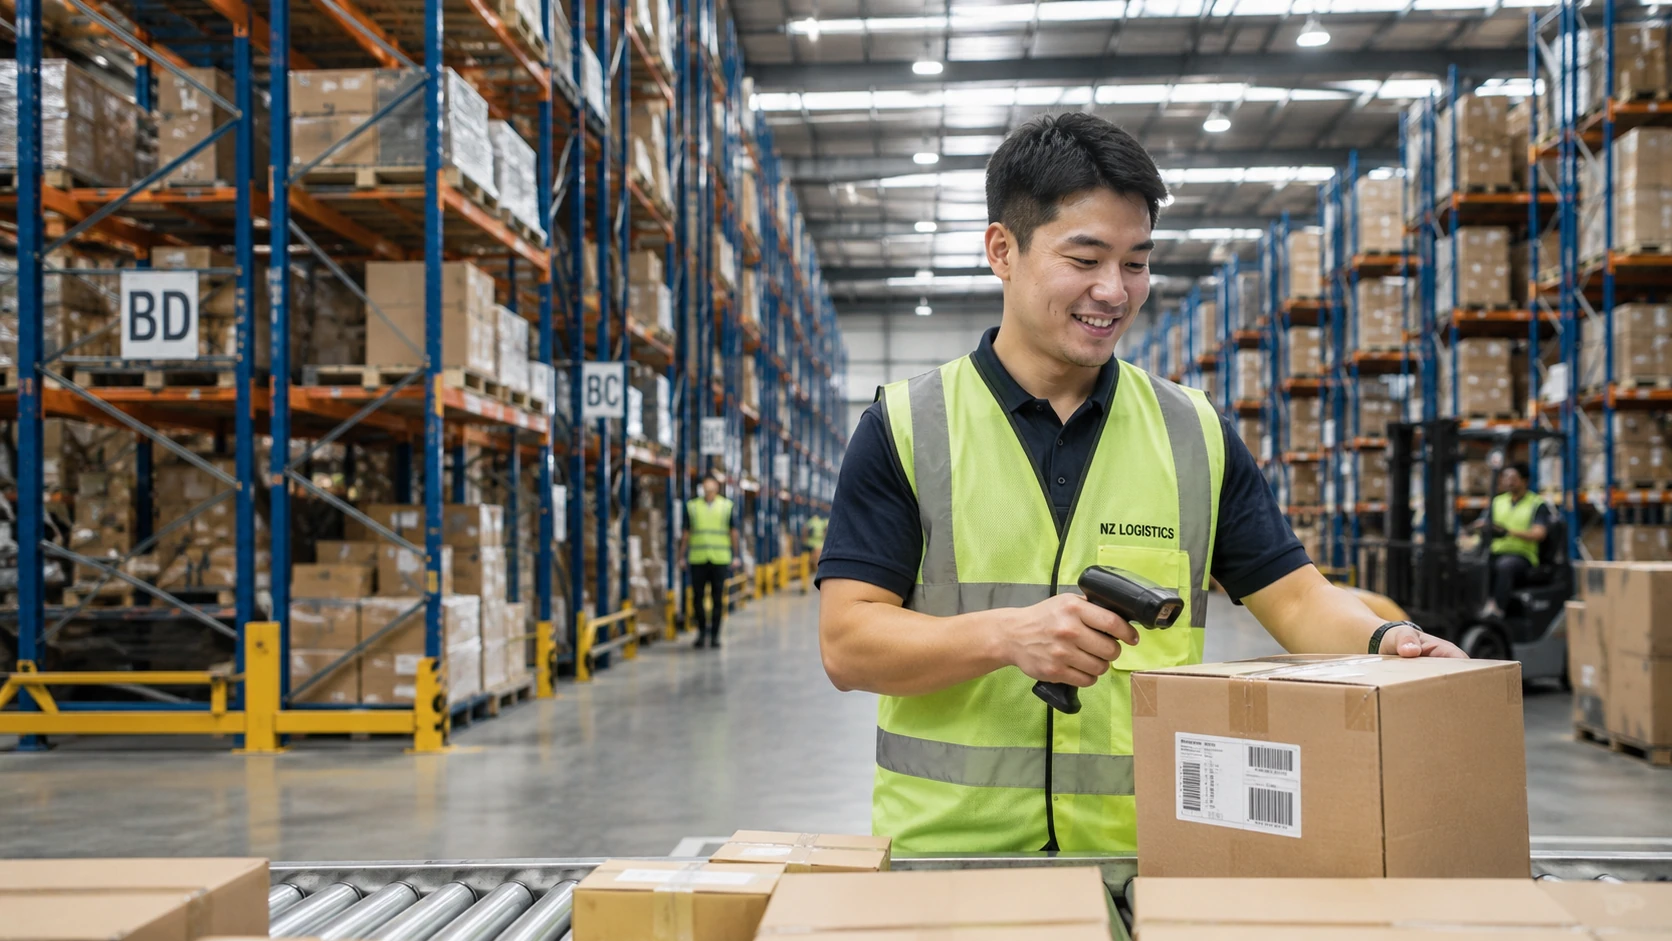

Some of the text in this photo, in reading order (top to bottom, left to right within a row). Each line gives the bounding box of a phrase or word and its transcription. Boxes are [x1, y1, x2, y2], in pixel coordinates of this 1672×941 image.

[129, 291, 191, 342] BD
[587, 374, 618, 407] BC
[1100, 522, 1175, 540] NZ LOGISTICS
